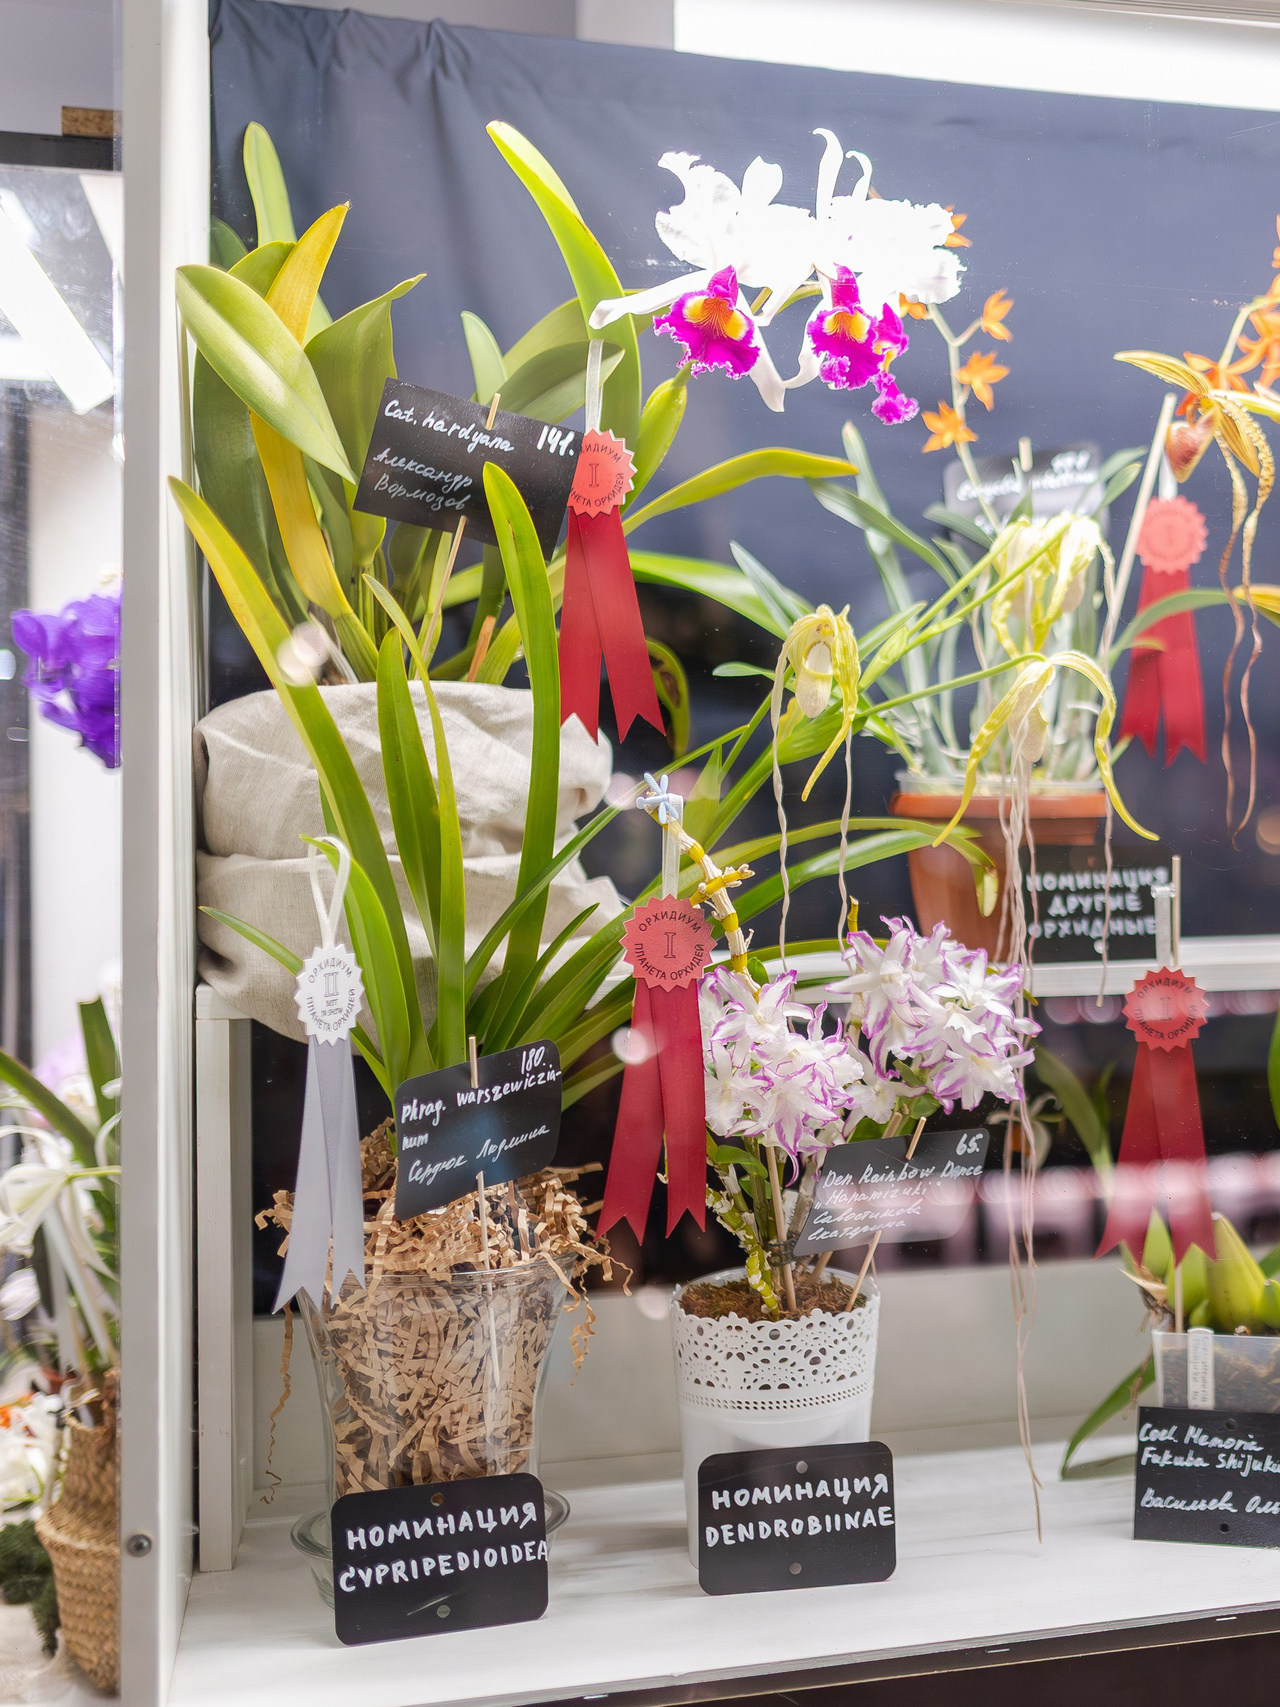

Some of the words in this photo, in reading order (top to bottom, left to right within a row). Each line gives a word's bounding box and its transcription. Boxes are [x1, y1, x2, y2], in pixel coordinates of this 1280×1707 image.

[384, 399, 417, 426] Cat.
[422, 411, 515, 454] hardyana
[373, 447, 473, 495] Александр
[638, 910, 702, 934] ОРХИДИУМ
[308, 957, 354, 984] ОРХИДИУМ
[634, 942, 667, 981] ПЛАНЕТА
[669, 943, 705, 981] ОРХИДЕЙ
[1137, 977, 1193, 1000] ОРХИДИУМ
[306, 996, 331, 1033] ПЛАНЕТА
[332, 987, 356, 1031] ОРХИДЕЙ
[520, 1046, 546, 1075] 180.
[408, 1154, 469, 1187] Сердюк
[475, 1123, 551, 1163] Людмила
[823, 1169, 855, 1190] Den.
[858, 1162, 937, 1185] Rainbow
[939, 1159, 985, 1181] Dance
[1183, 1424, 1265, 1452] Memoria
[712, 1472, 889, 1511] НОМИНАЦИЯ
[346, 1501, 539, 1551] НОМИНАЦИЯ
[704, 1505, 896, 1548] DENDROBIINAE
